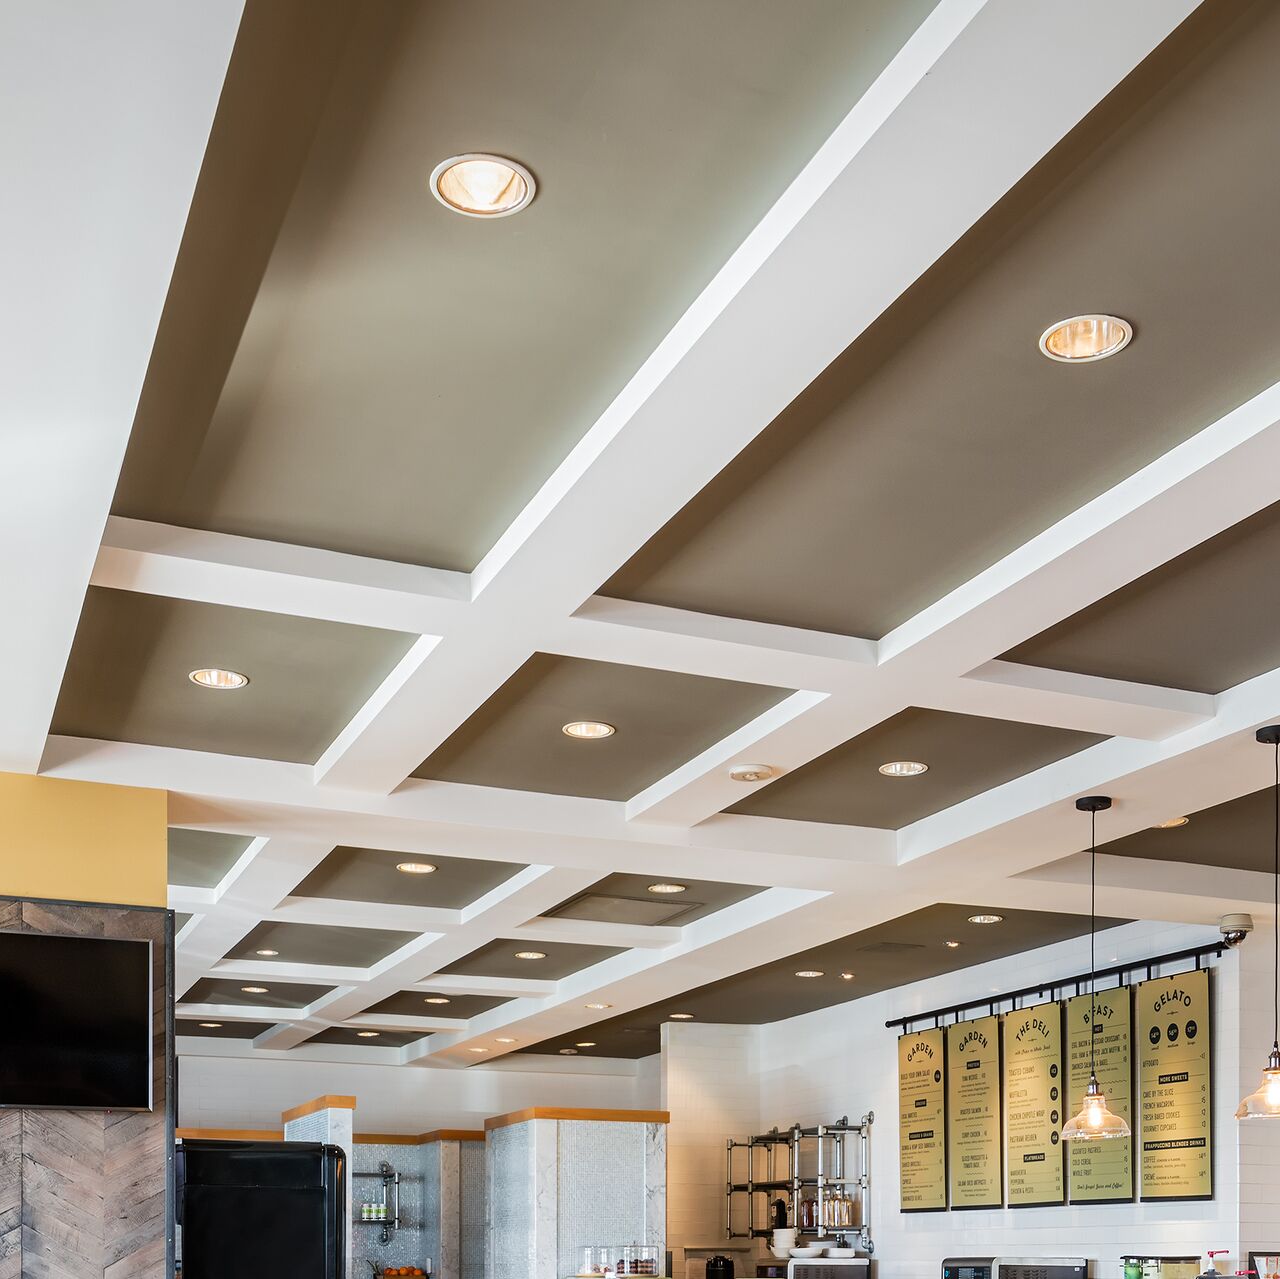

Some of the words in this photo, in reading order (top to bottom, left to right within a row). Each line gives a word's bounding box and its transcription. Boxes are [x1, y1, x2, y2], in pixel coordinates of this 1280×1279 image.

[1154, 989, 1191, 1012] GELATO
[1016, 1021, 1030, 1042] THE
[1033, 1018, 1050, 1038] DELI
[907, 1042, 934, 1062] GARDEN
[959, 1031, 988, 1052] GARDEN
